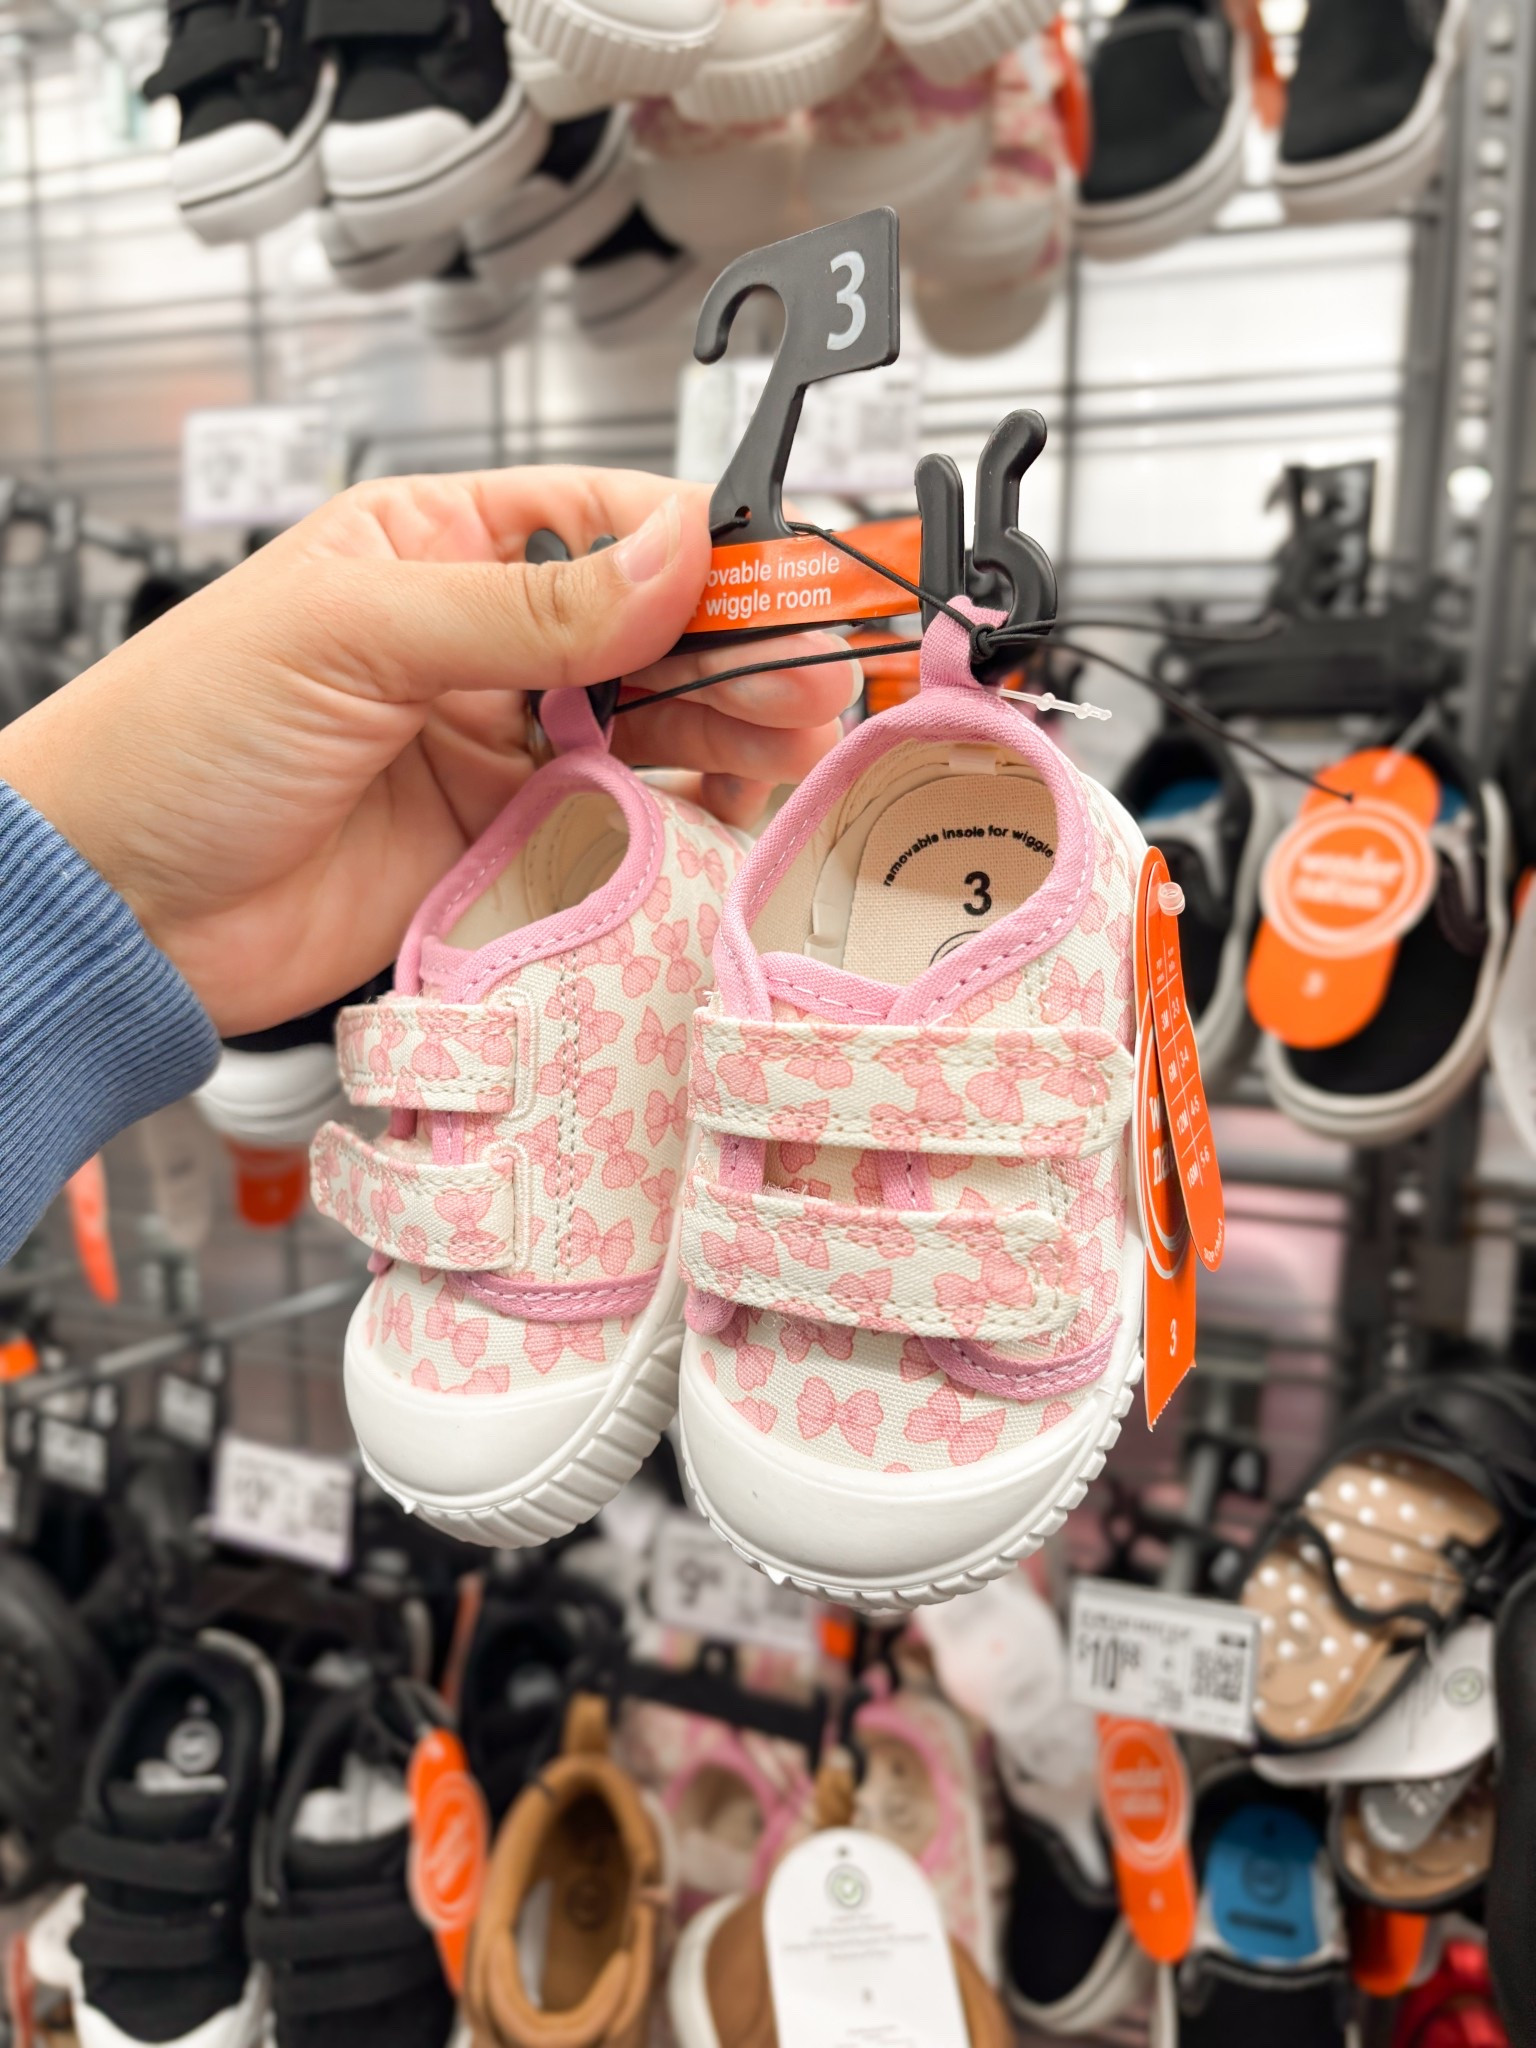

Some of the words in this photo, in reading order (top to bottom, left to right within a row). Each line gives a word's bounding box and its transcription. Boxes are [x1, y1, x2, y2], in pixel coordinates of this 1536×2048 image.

[827, 251, 866, 350] 3
[707, 559, 772, 587] ovable
[777, 551, 840, 580] insole
[706, 589, 771, 620] wiggle
[776, 587, 832, 610] room
[883, 834, 939, 887] removable
[942, 827, 984, 840] insole
[988, 825, 1009, 838] for
[1012, 830, 1054, 858] wiggle
[963, 871, 992, 916] 3
[1169, 1318, 1178, 1357] 3
